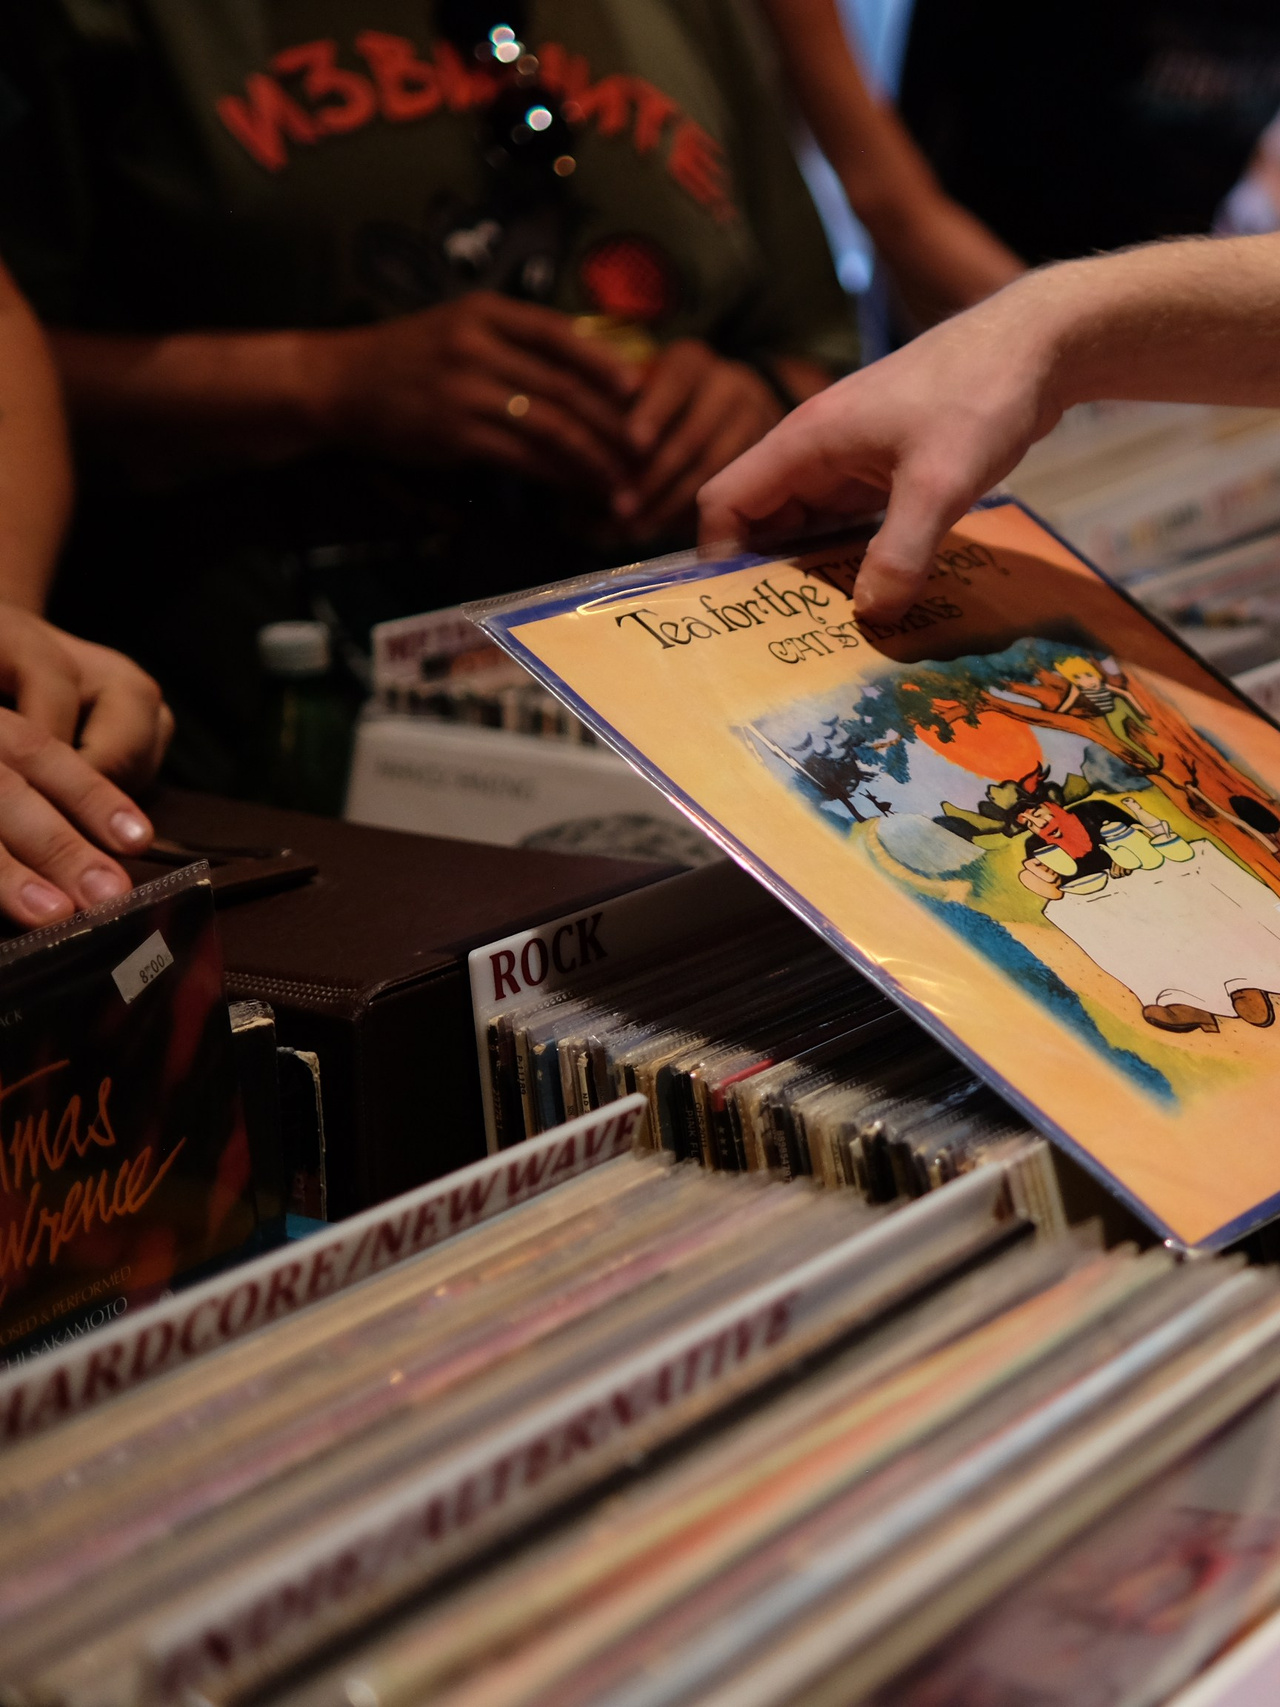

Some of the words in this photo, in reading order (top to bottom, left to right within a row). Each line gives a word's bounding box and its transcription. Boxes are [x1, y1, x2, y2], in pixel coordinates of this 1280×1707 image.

[615, 608, 720, 650] Tea
[701, 594, 766, 633] for
[752, 578, 830, 625] the
[768, 629, 835, 665] CAT
[488, 911, 609, 1001] ROCK
[505, 1106, 643, 1199] WAVE
[684, 1109, 696, 1136] PINK
[52, 1265, 132, 1318] PERFORMED
[30, 1296, 128, 1357] SAKAMOTO
